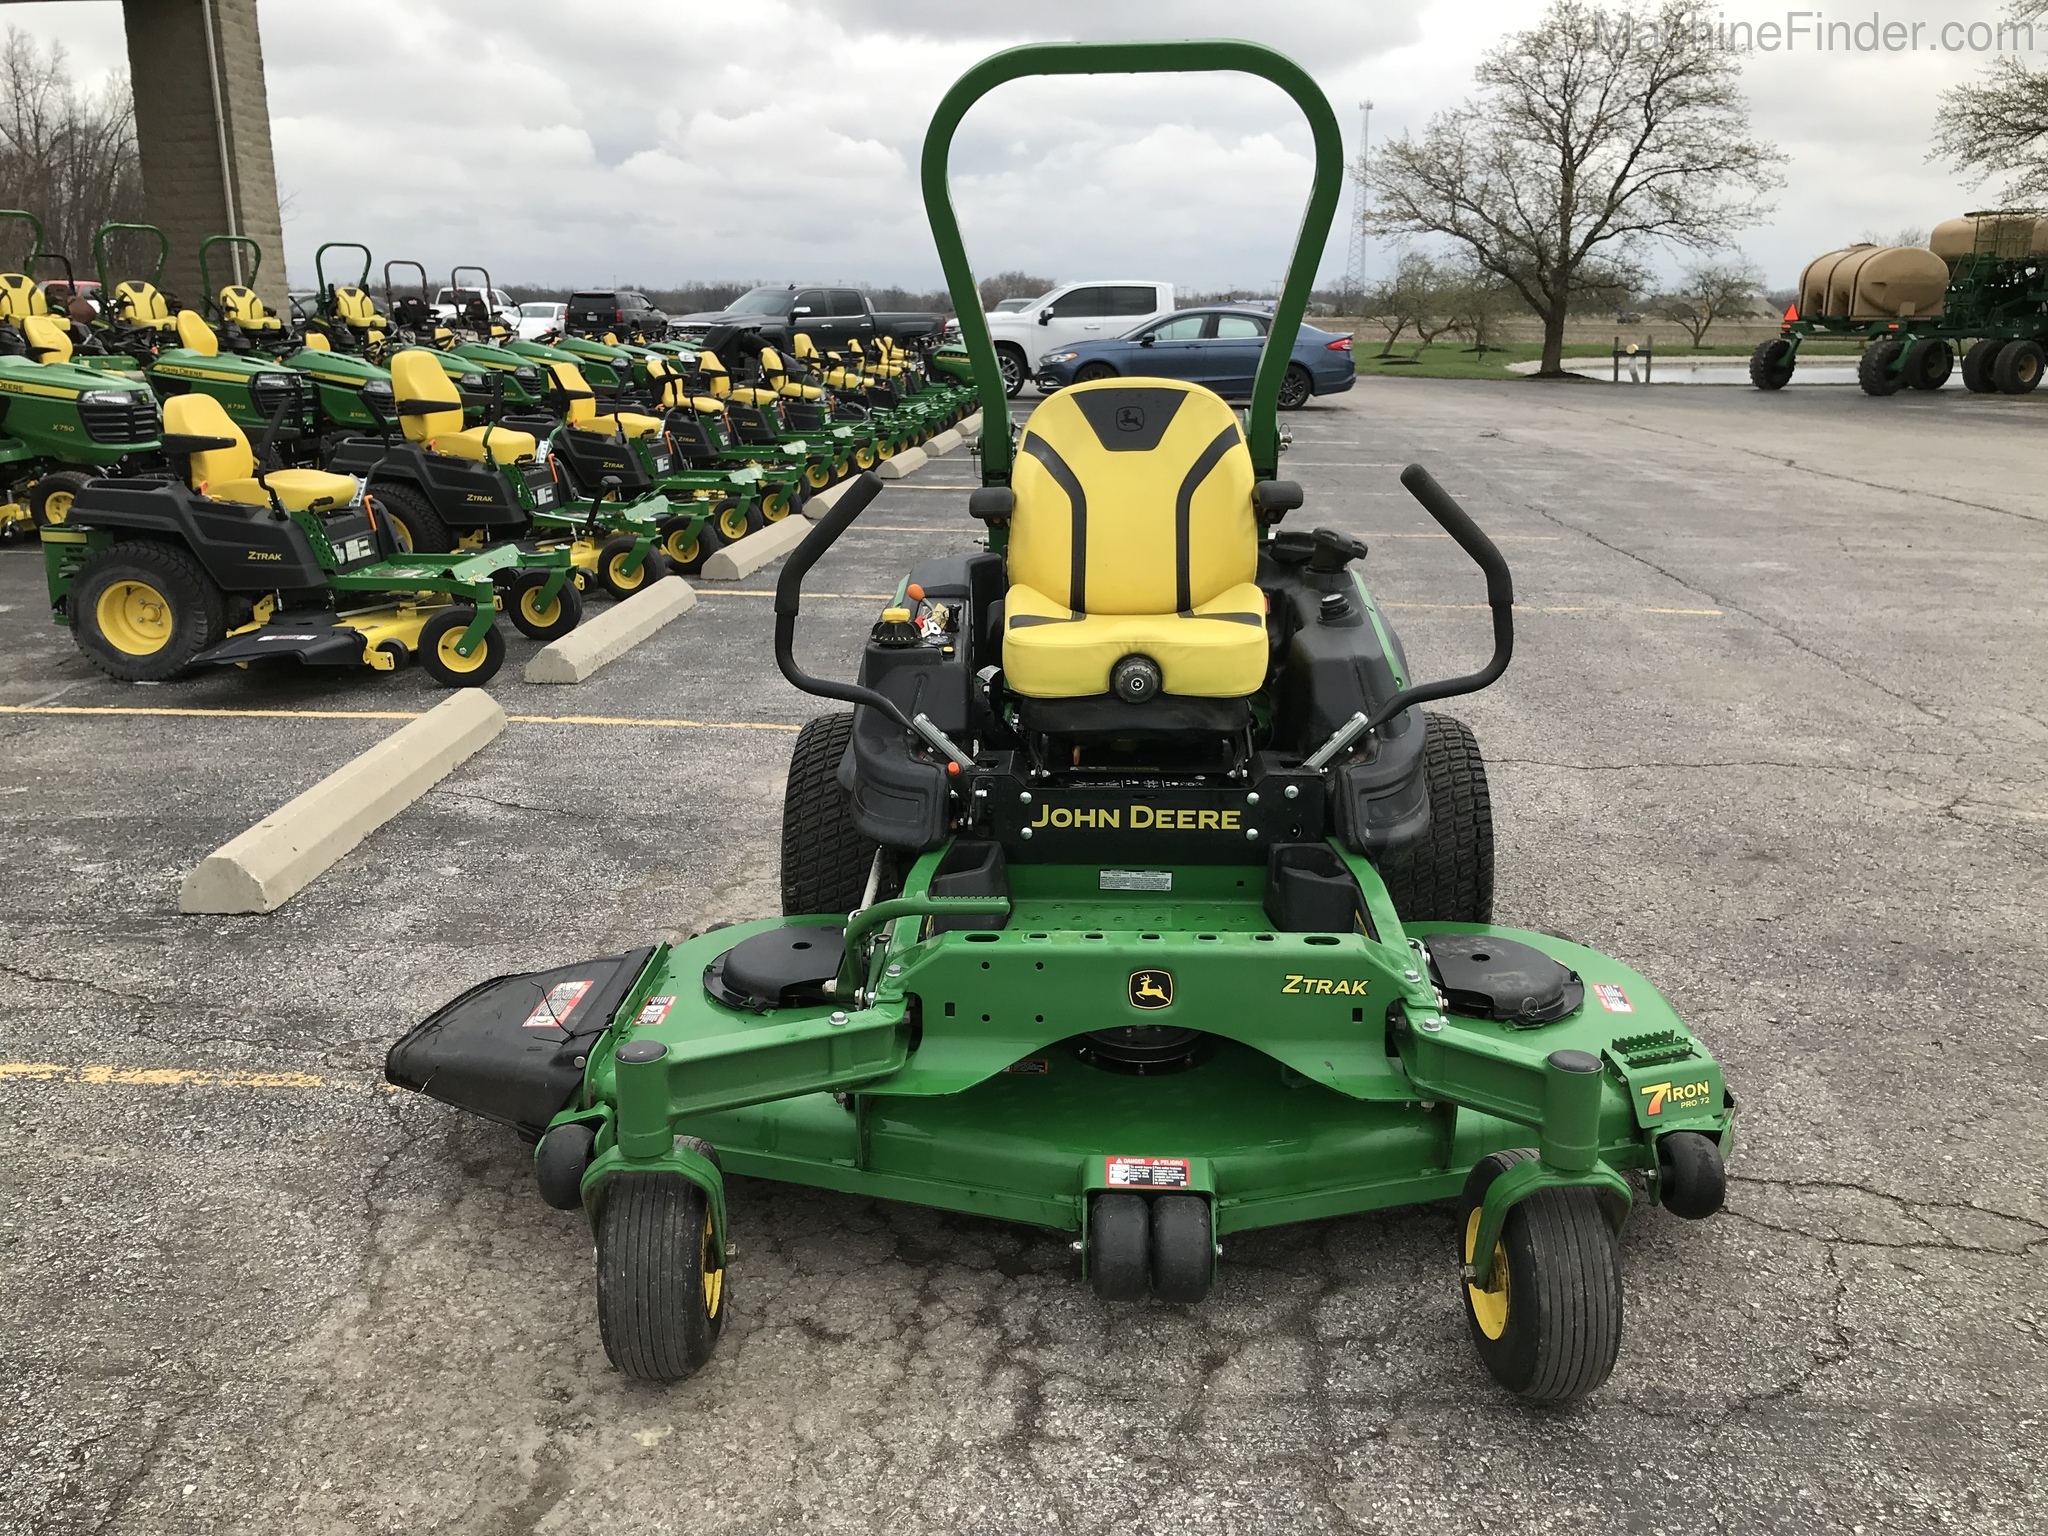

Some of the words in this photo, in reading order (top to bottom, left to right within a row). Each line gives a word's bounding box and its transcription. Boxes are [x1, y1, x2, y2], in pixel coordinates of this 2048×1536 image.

[602, 461, 625, 469] ZTRAK
[466, 493, 494, 502] ZTRAK
[247, 551, 282, 561] ZTRAK
[1031, 804, 1120, 828] JOHN
[1130, 805, 1241, 830] DEERE
[1281, 974, 1369, 995] ZTRAK
[1680, 1099, 1698, 1109] PRO
[1699, 1096, 1710, 1105] 72
